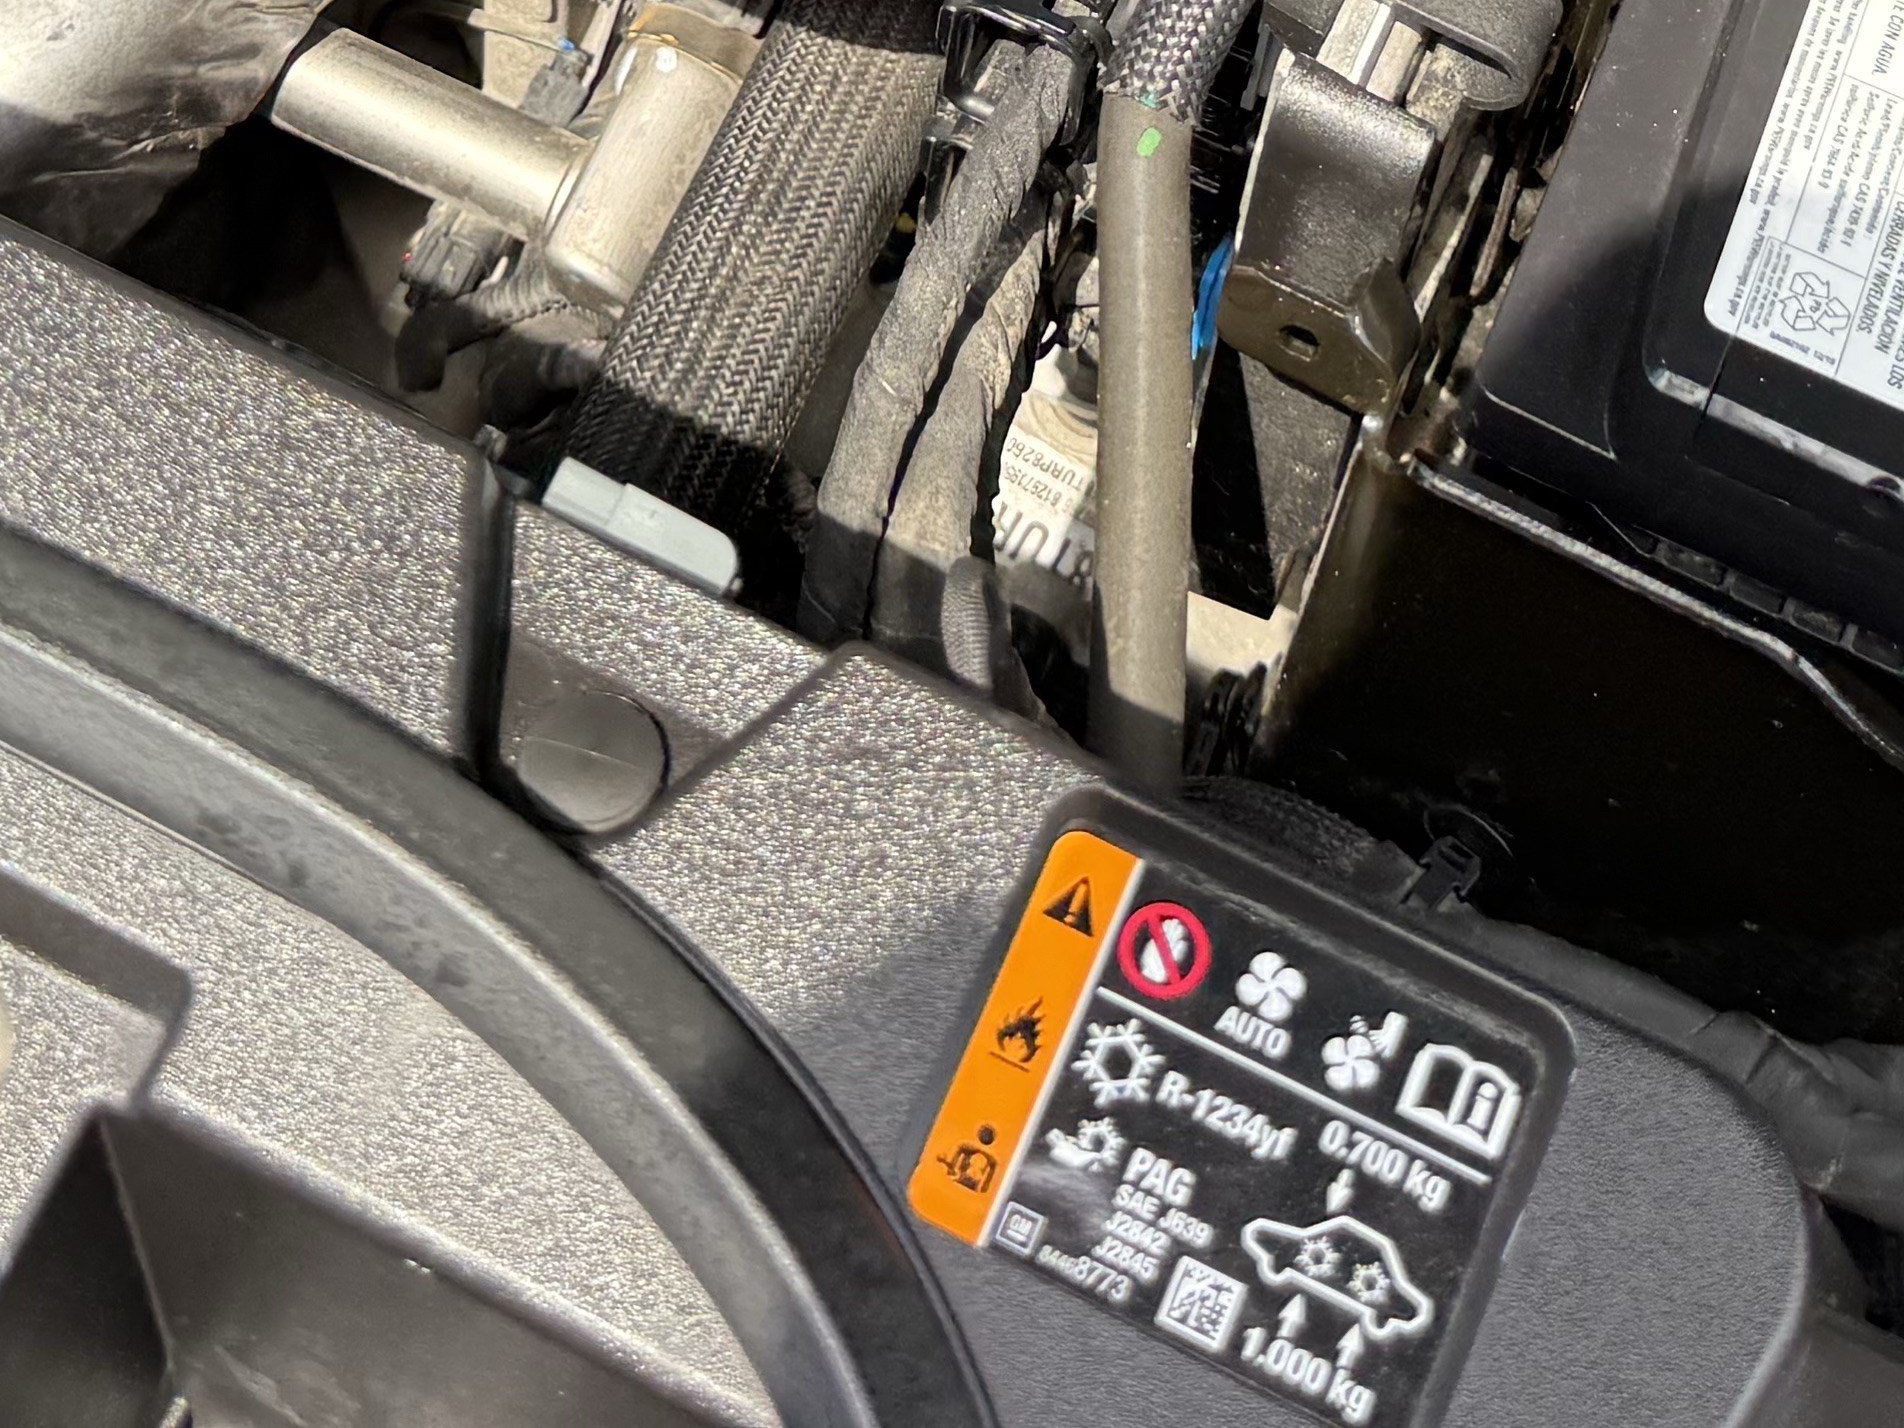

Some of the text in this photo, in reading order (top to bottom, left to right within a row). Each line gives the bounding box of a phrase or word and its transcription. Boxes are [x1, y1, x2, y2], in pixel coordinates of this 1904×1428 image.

[1883, 13, 1904, 41] CON
[1876, 259, 1892, 271] Y
[1212, 1004, 1291, 1059] AUTO
[1154, 1069, 1298, 1160] R-1234yf
[1121, 1146, 1197, 1206] PAG
[1317, 1118, 1451, 1212] 0.700 kg
[1101, 1209, 1171, 1256] J2842
[1113, 1182, 1213, 1247] SAE J639
[1088, 1234, 1160, 1283] J2845
[1239, 1325, 1377, 1423] 1.000 kg
